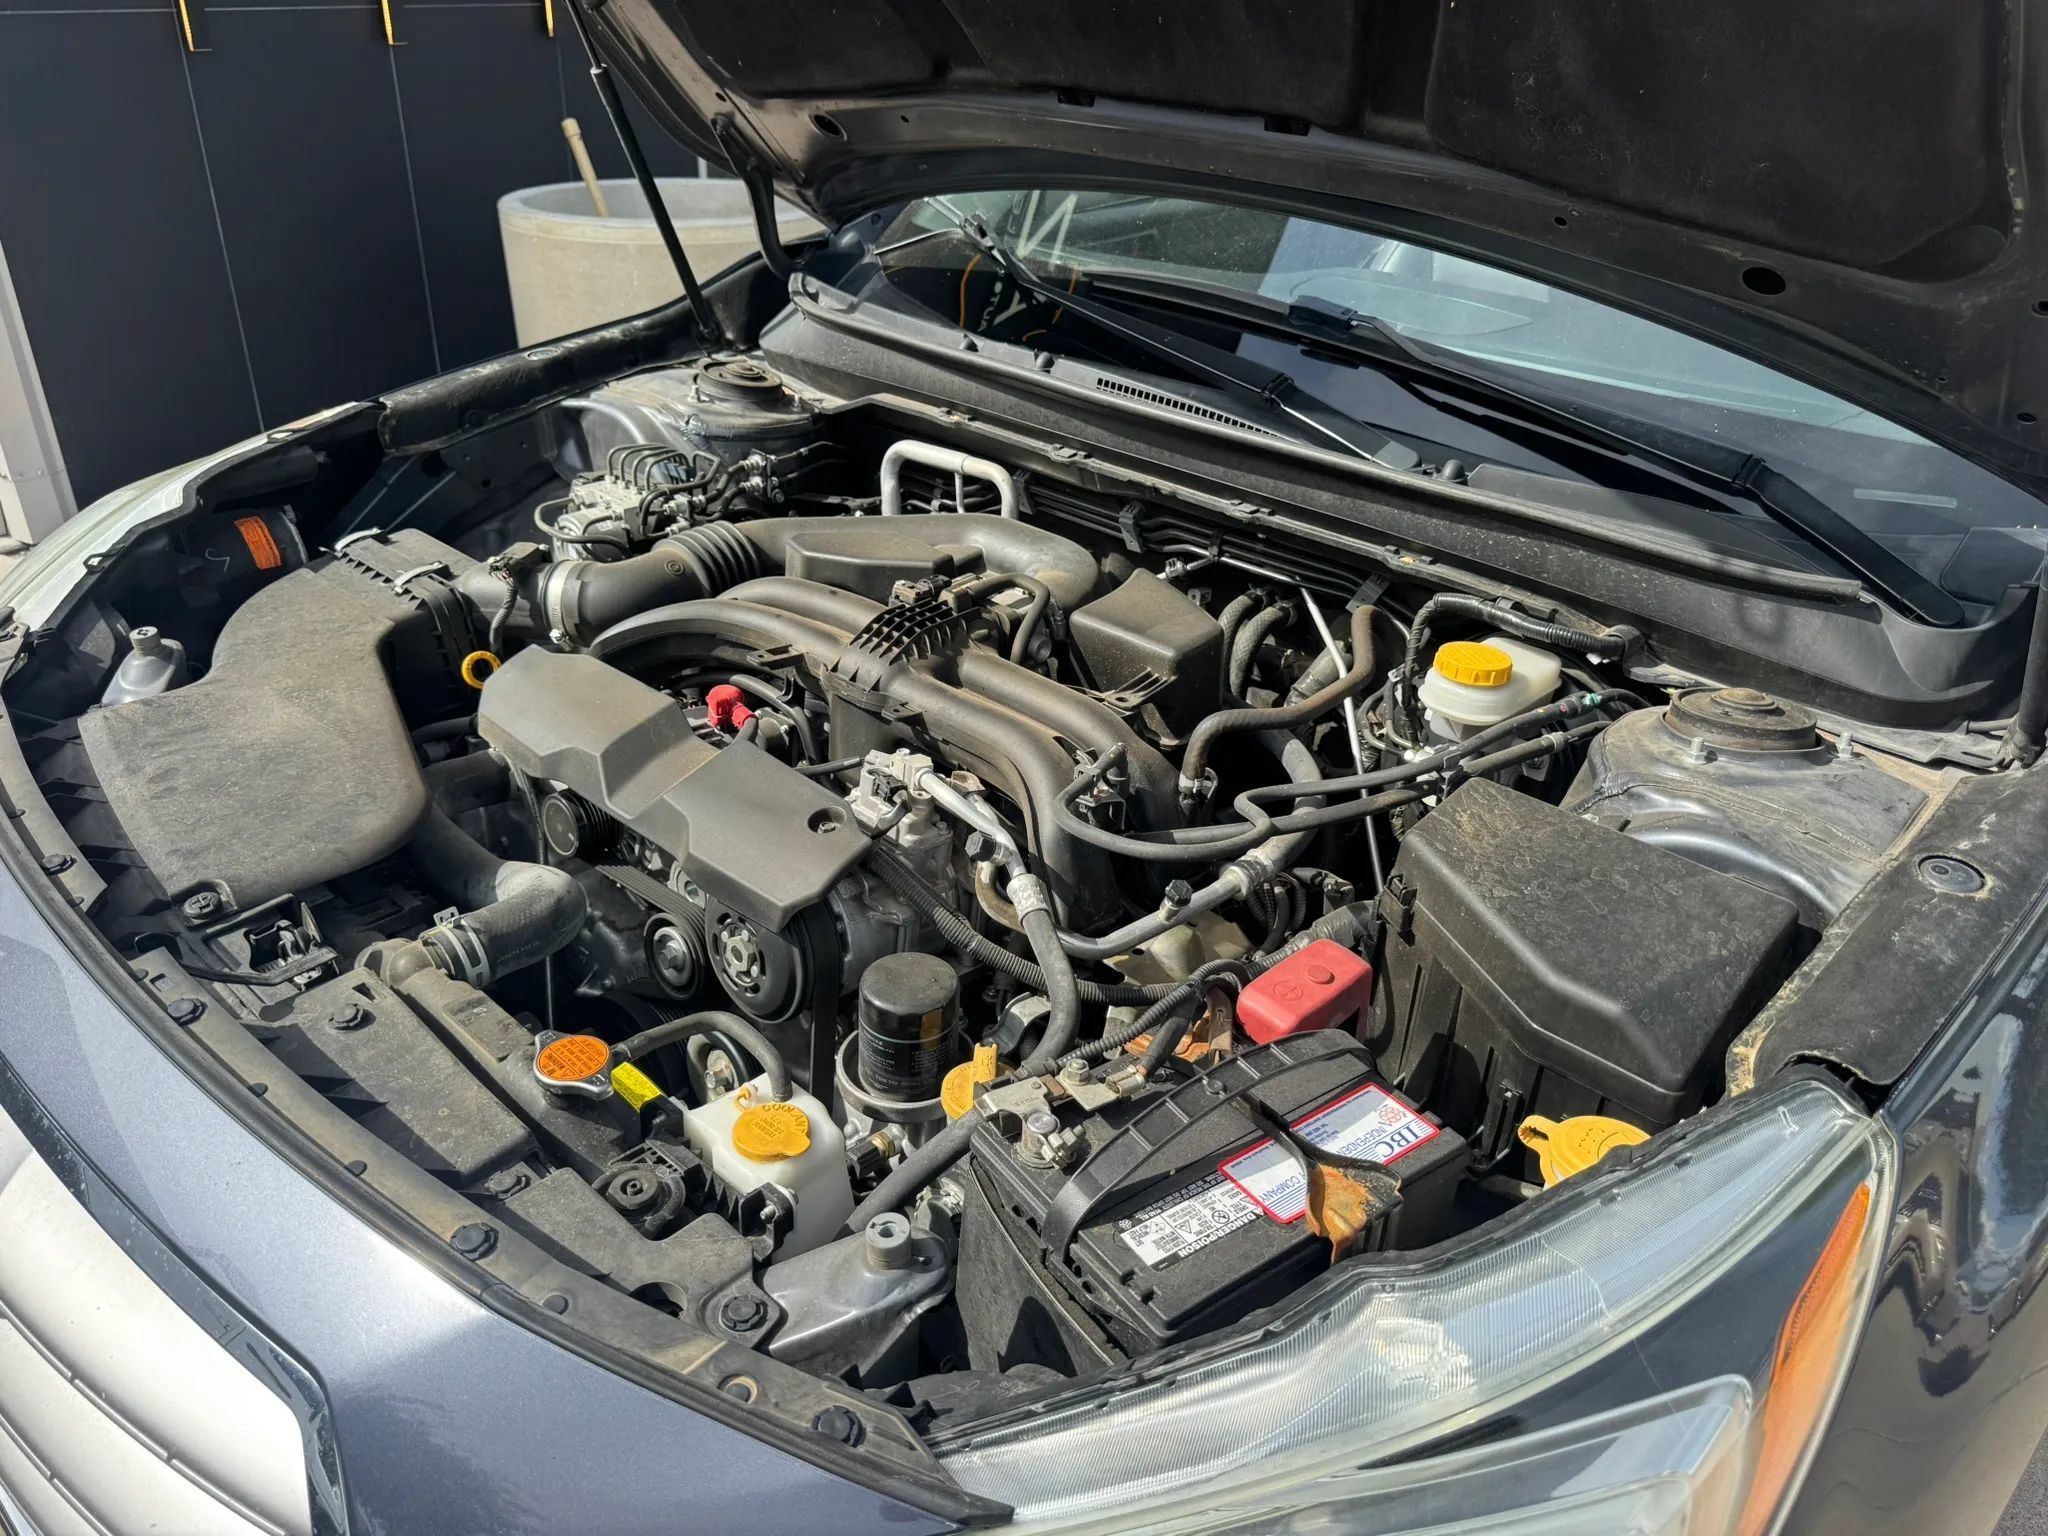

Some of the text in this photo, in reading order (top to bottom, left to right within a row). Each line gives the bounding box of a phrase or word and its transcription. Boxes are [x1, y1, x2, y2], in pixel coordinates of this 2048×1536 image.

[1335, 1126, 1387, 1157] INDEPENDEN
[1373, 1125, 1421, 1158] IBC
[1258, 1176, 1300, 1203] COMPANY
[1177, 1211, 1255, 1256] DANGER/POISON
